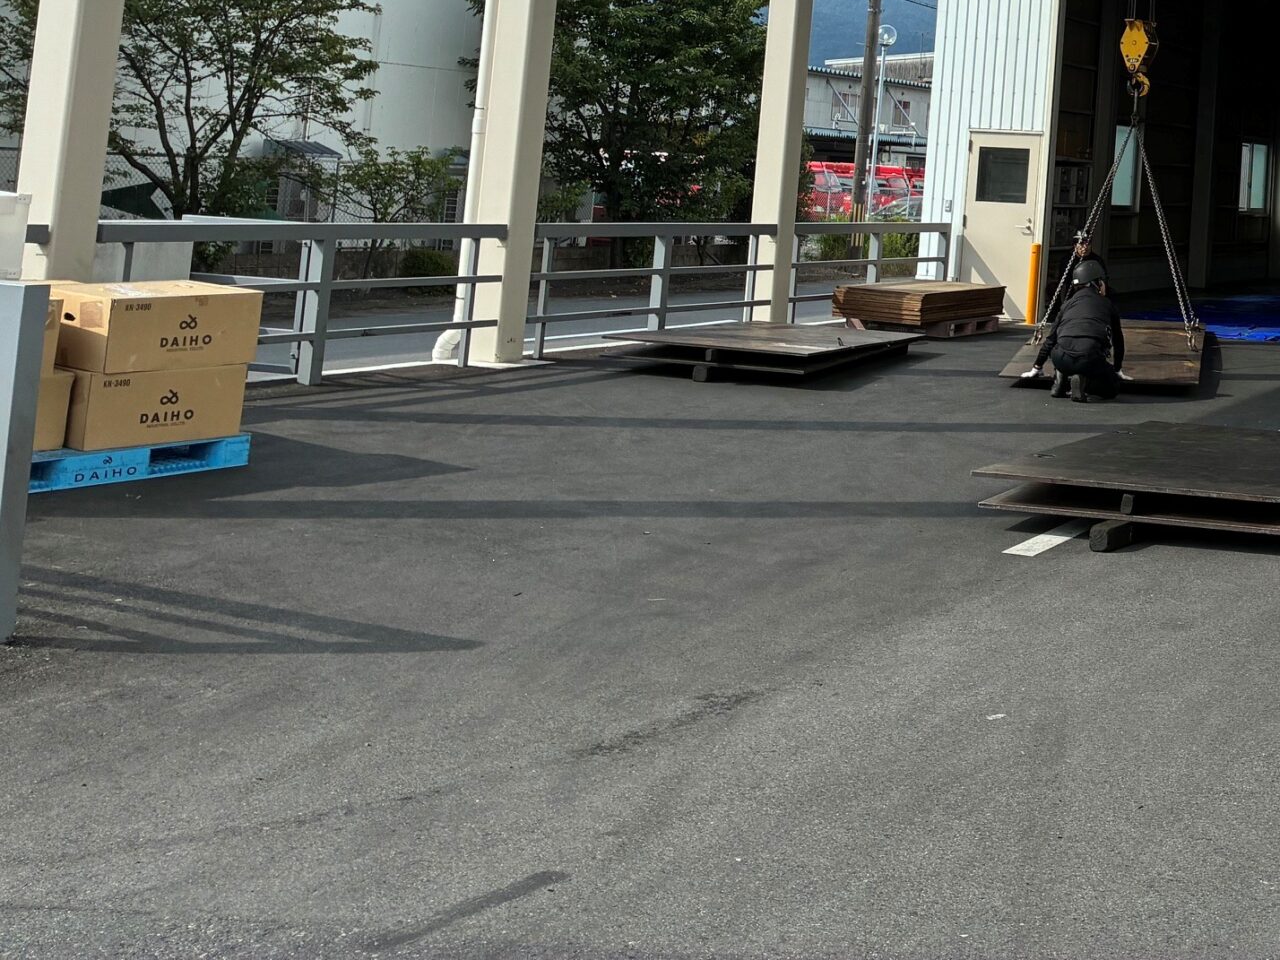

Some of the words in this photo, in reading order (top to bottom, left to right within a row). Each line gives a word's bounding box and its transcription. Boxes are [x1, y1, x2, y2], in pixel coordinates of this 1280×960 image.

[160, 334, 212, 348] DAIHO
[139, 409, 194, 424] DAIHO
[74, 466, 137, 483] DAIHO
